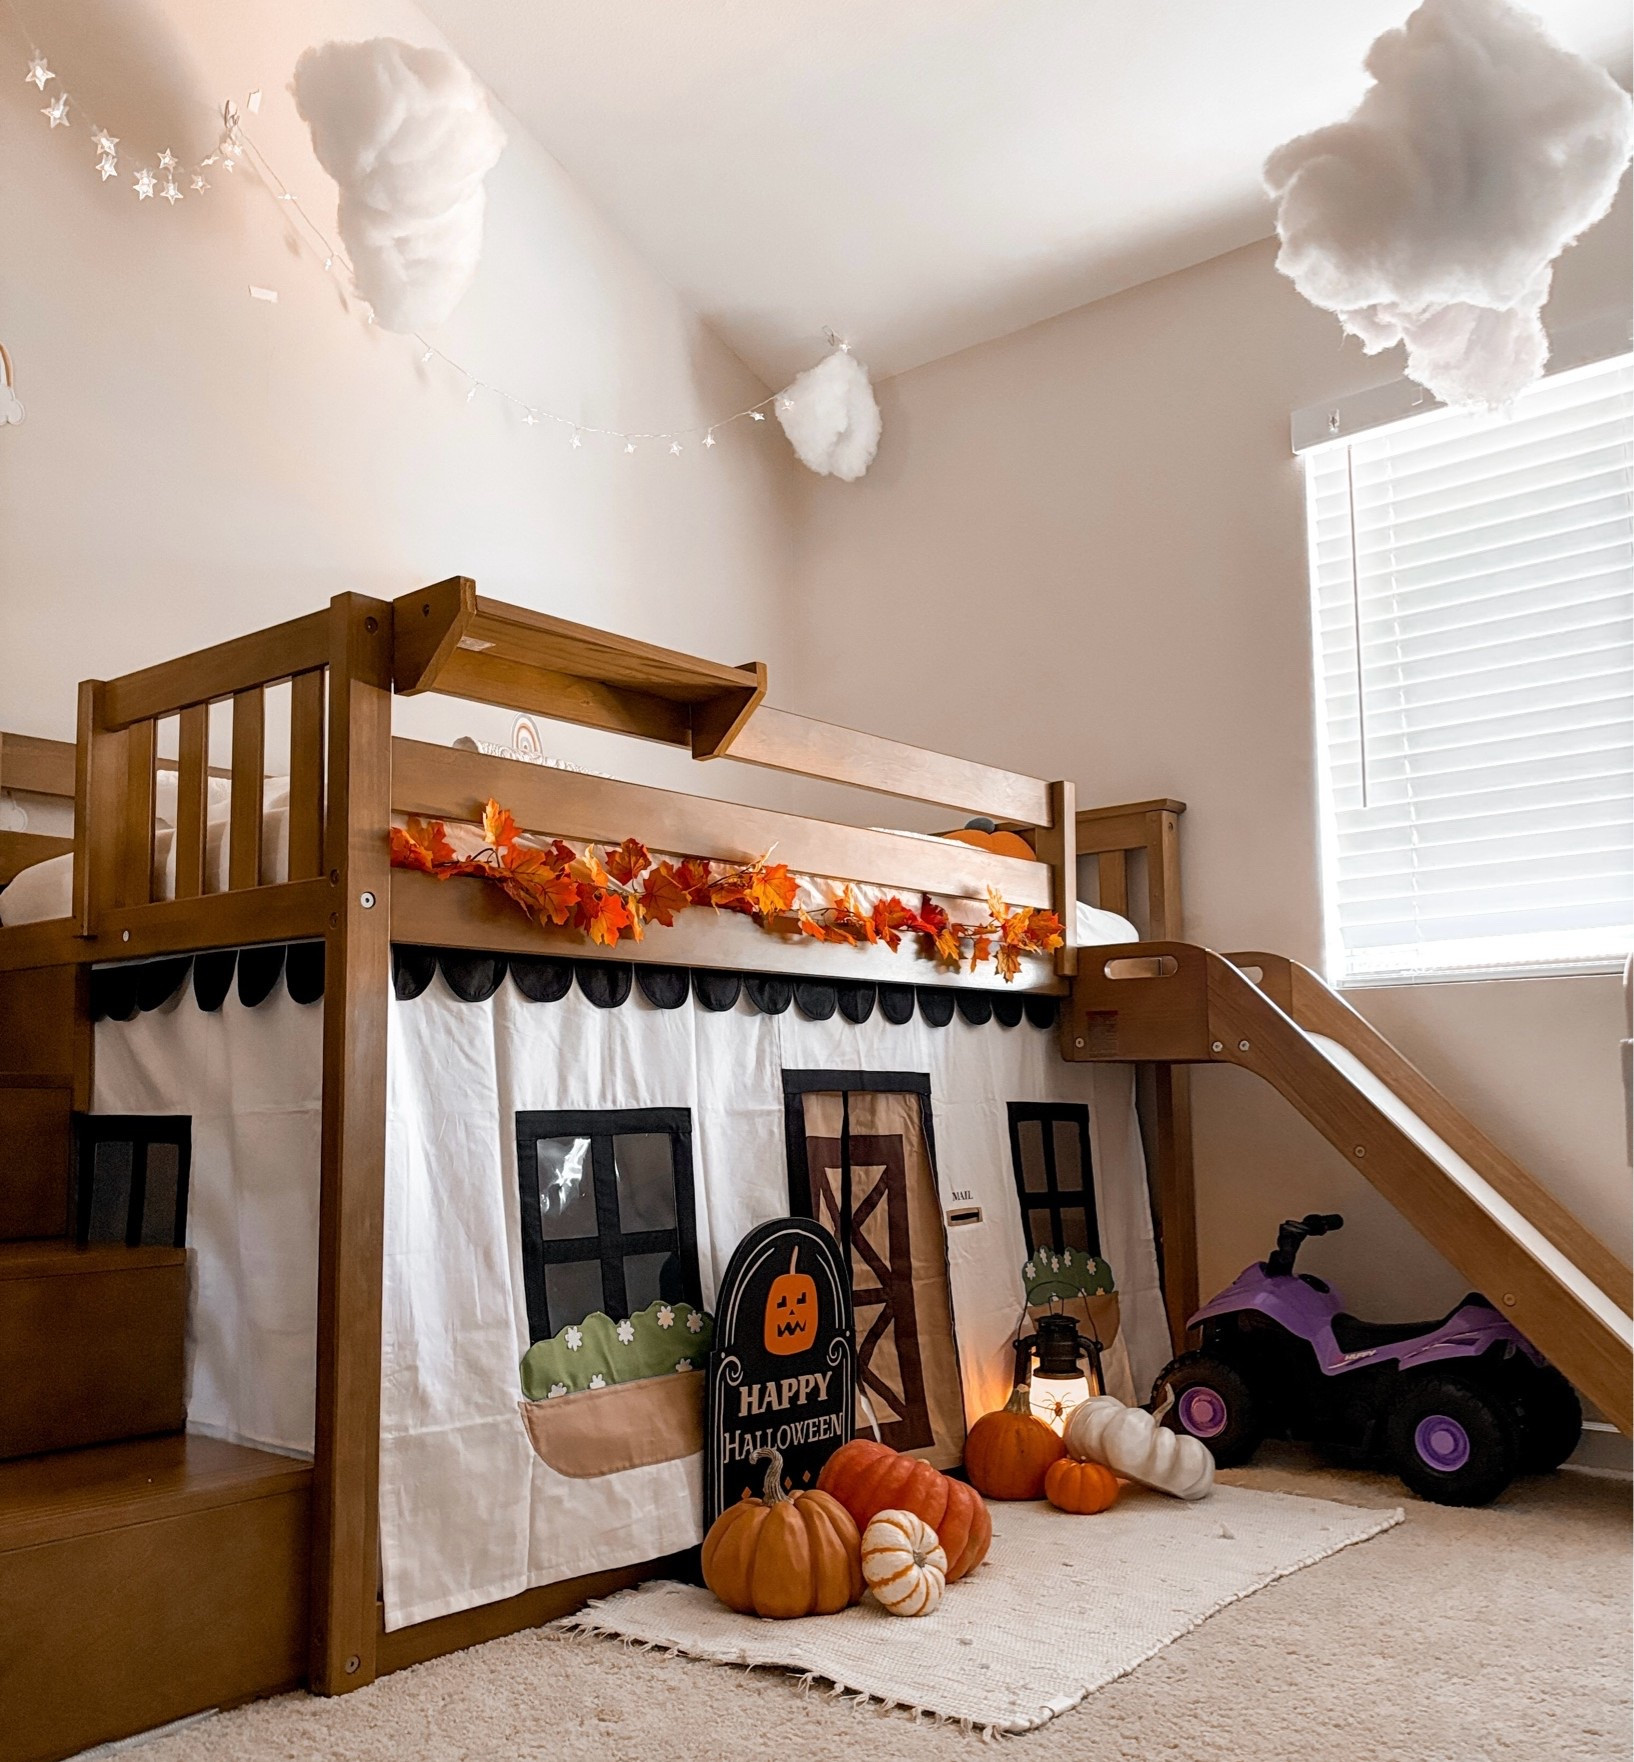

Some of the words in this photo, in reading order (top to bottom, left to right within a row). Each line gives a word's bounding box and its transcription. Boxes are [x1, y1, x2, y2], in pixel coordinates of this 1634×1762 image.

[952, 1190, 974, 1201] MAIL
[738, 1371, 833, 1417] HAPPY
[723, 1412, 844, 1464] HALLOWEEN
